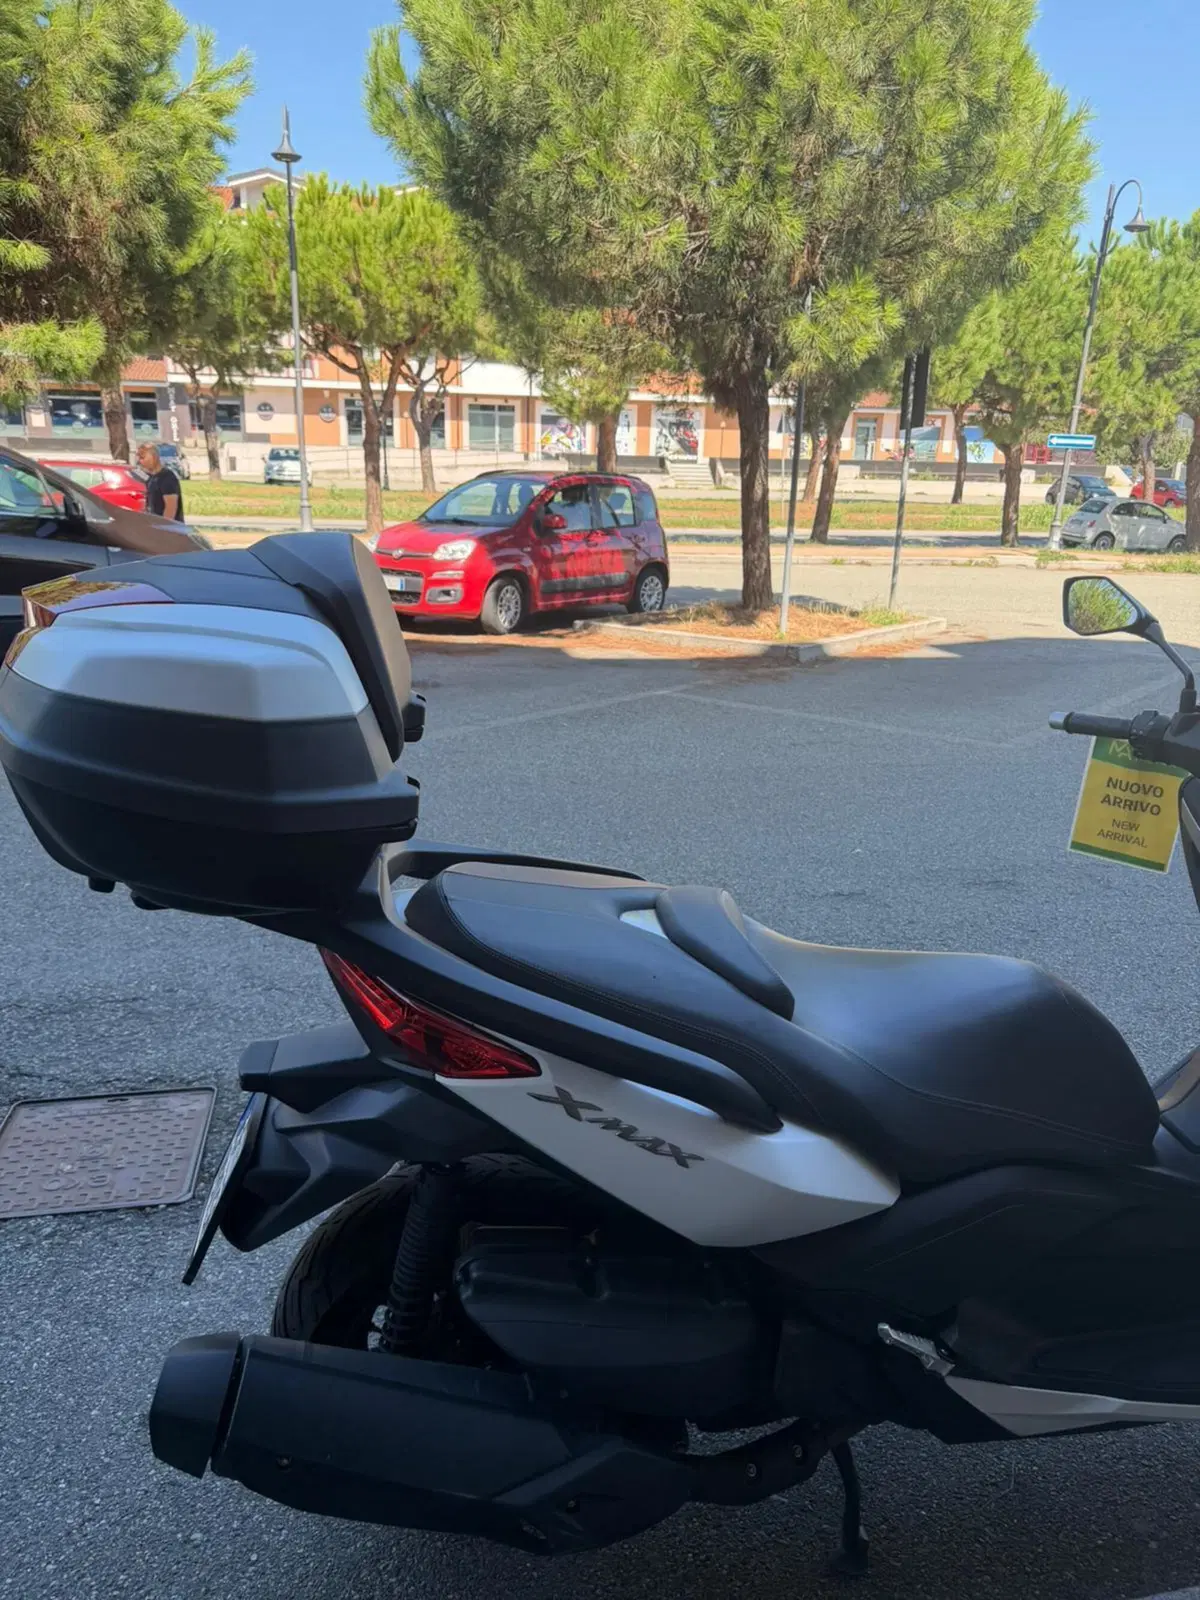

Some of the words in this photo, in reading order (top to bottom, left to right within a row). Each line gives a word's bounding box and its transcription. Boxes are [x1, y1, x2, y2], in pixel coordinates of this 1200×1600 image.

[1106, 776, 1164, 798] NUOVO
[1100, 793, 1161, 816] ARRIVO
[1111, 818, 1140, 832] NEW
[1097, 828, 1148, 848] ARRIVAL
